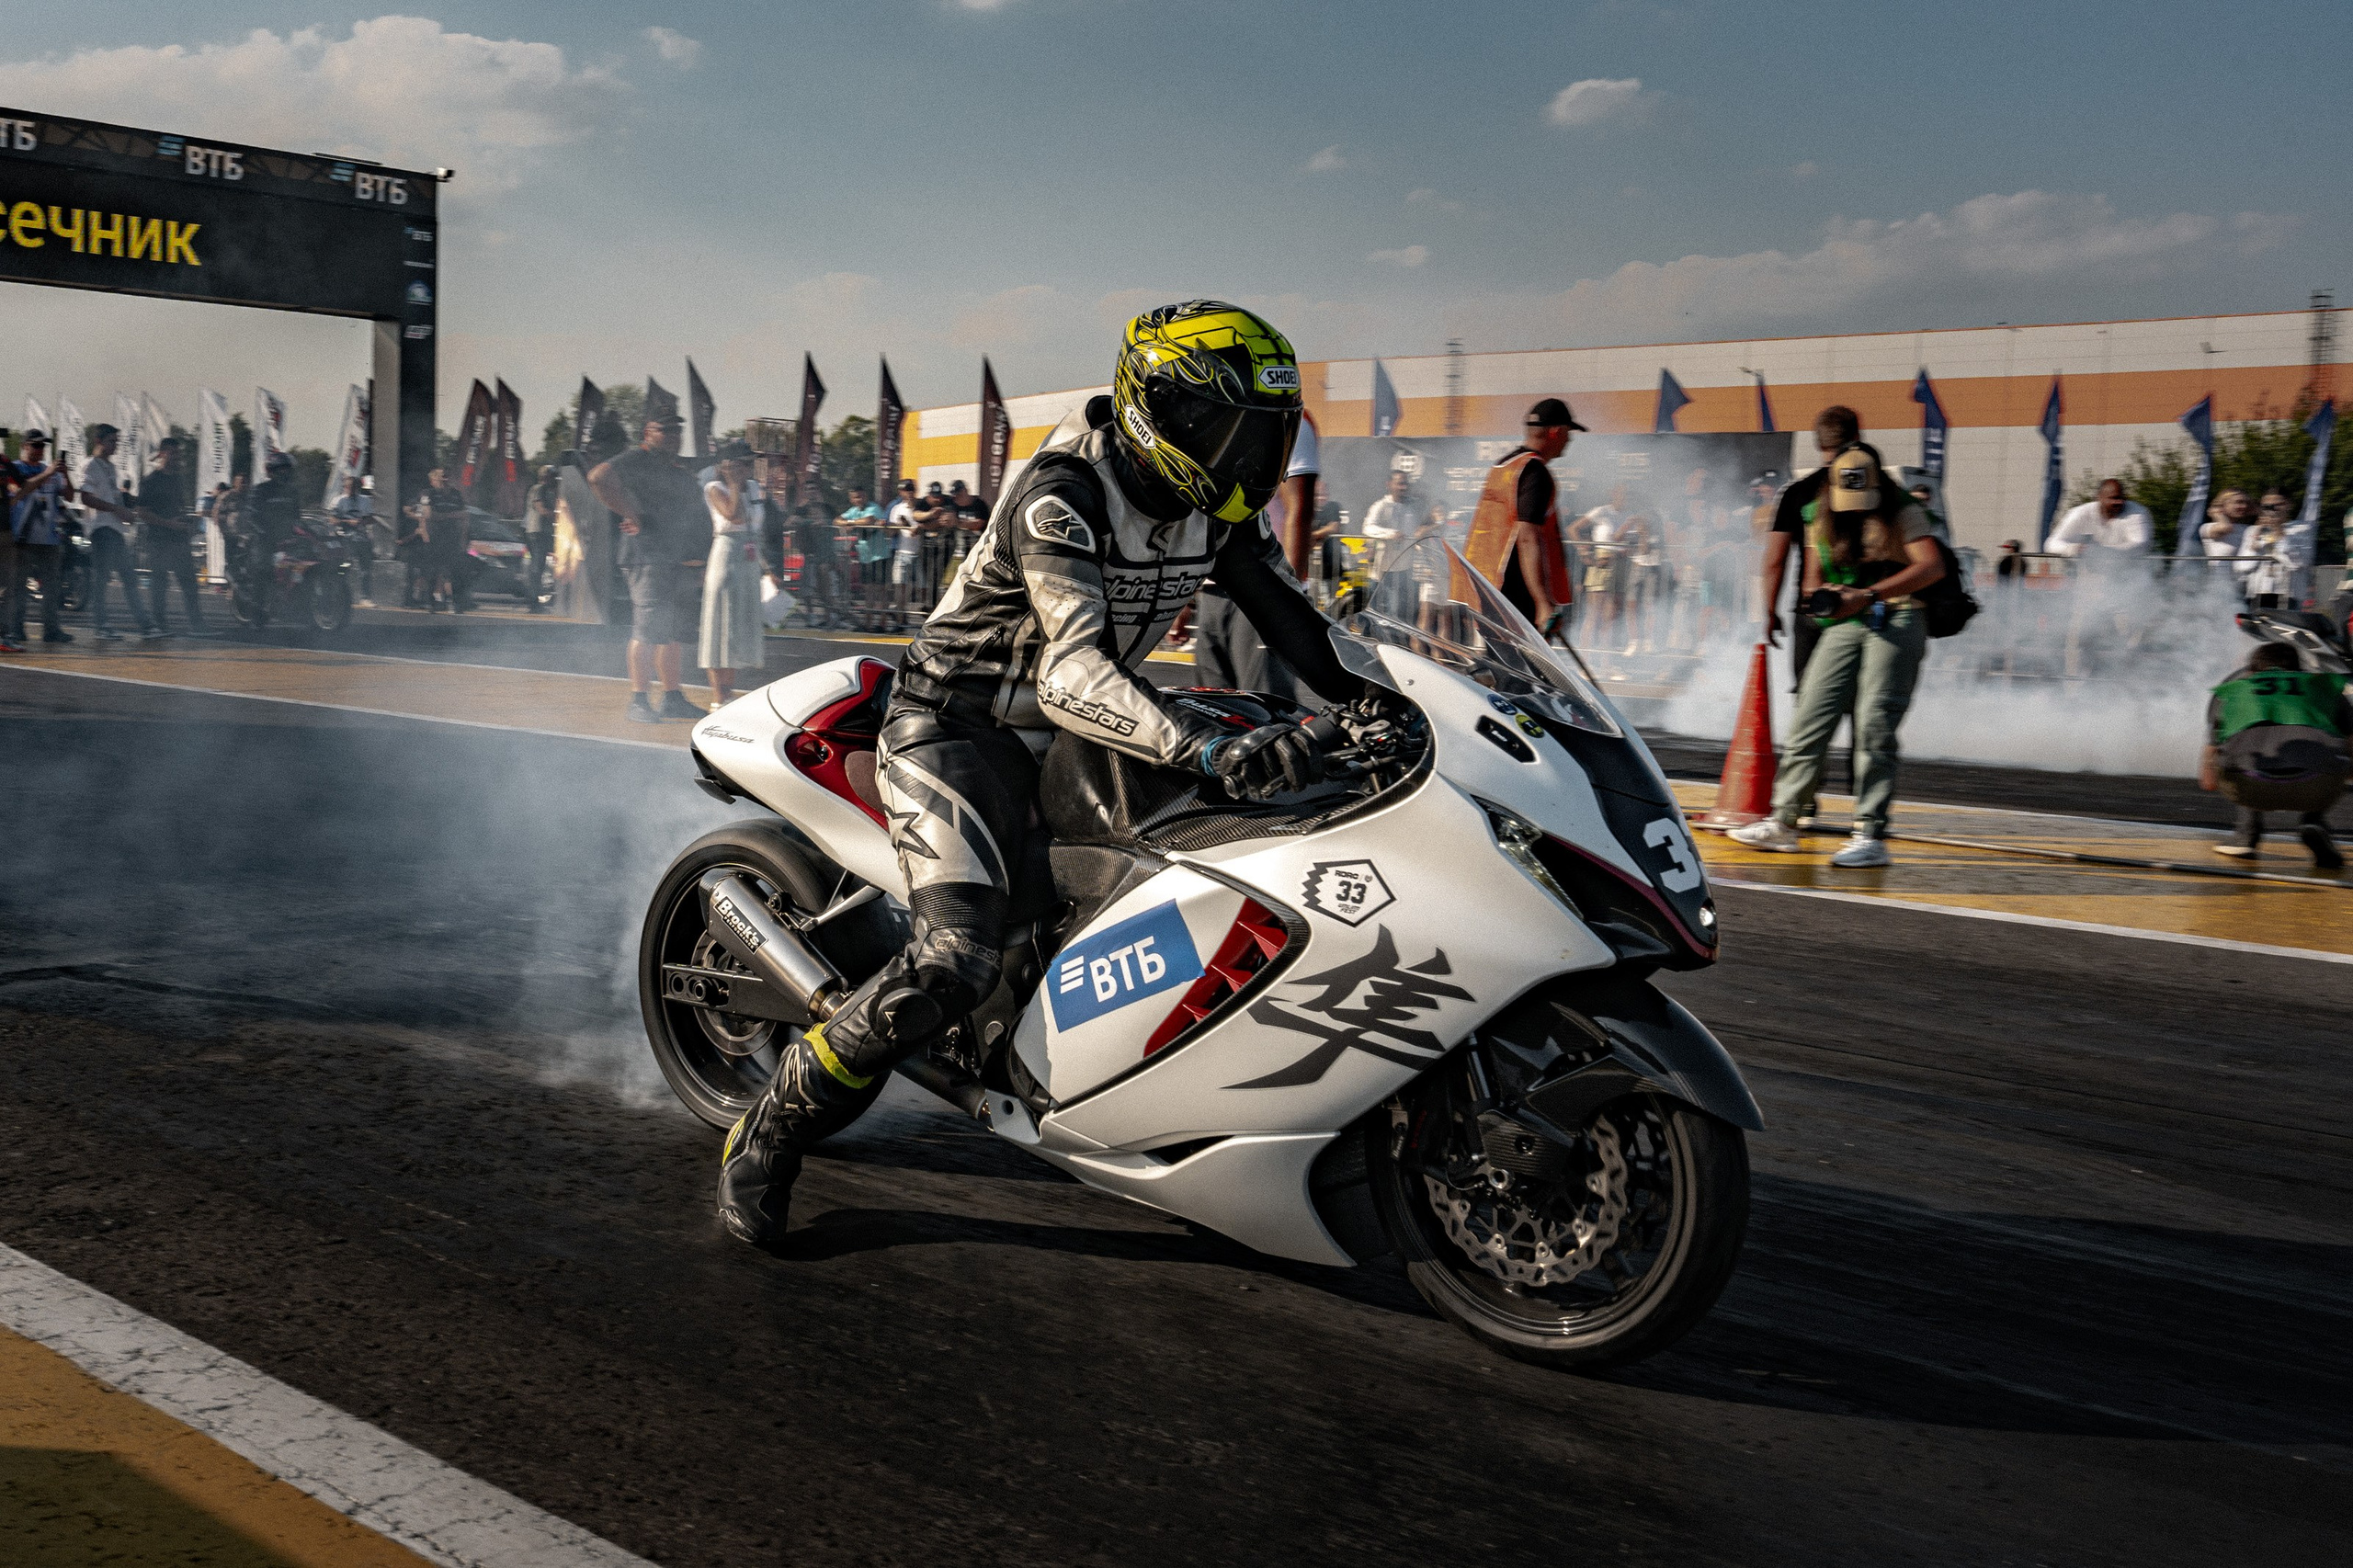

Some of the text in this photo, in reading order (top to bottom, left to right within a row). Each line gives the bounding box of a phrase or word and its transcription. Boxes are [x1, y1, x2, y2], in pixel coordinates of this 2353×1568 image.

[186, 145, 245, 180] ВТБ
[355, 172, 409, 205] ВТБ
[0, 199, 202, 267] ечник
[1128, 411, 1152, 445] SHOEI
[2250, 676, 2304, 696] 31
[1037, 680, 1137, 735] alpinestars
[1336, 881, 1367, 904] 33
[717, 899, 760, 946] Brock's
[1089, 936, 1166, 1003] ВТБ
